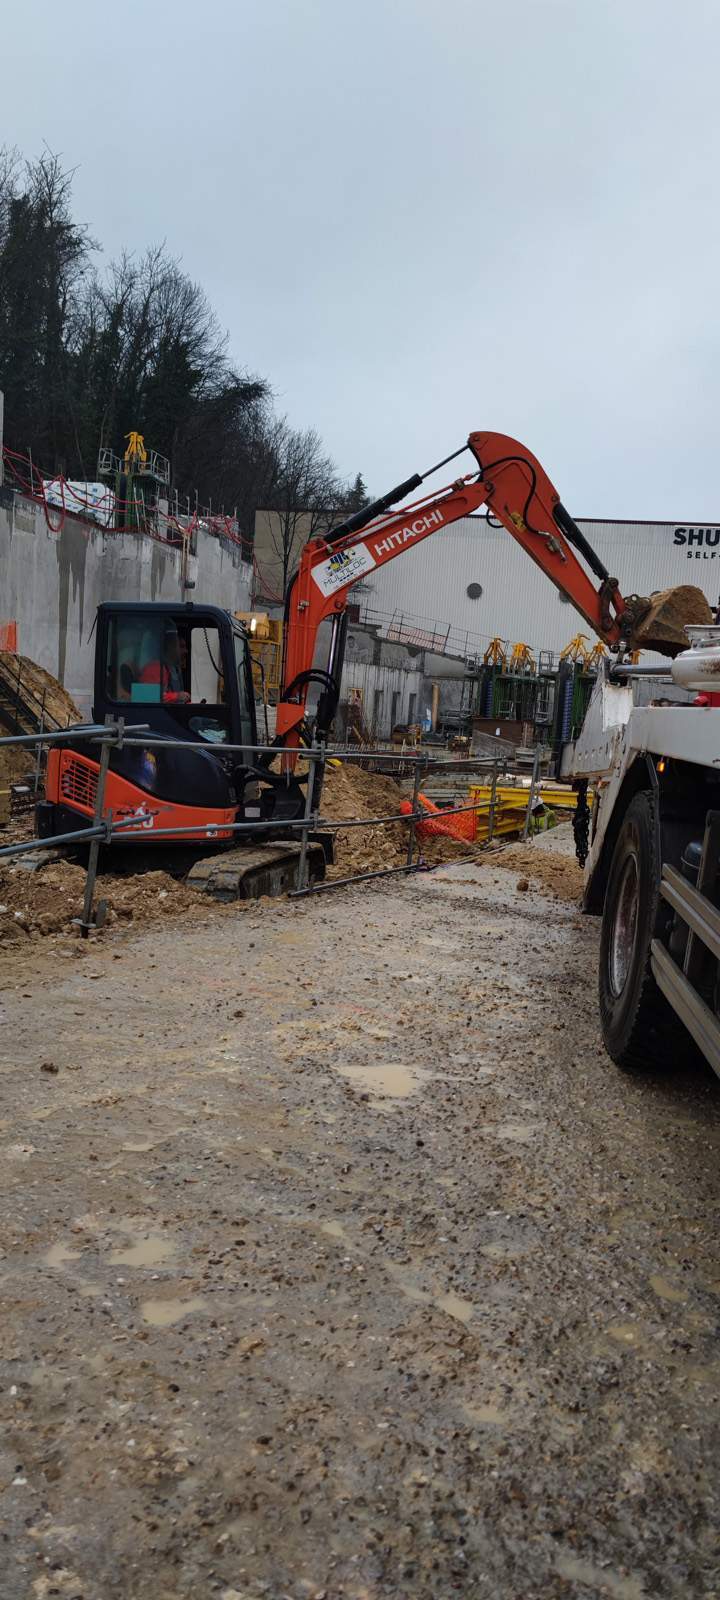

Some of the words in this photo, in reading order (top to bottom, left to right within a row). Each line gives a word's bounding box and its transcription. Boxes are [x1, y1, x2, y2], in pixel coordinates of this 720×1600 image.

[374, 509, 444, 556] HITACHI
[673, 528, 720, 546] SHU
[322, 557, 367, 588] MULTILOC
